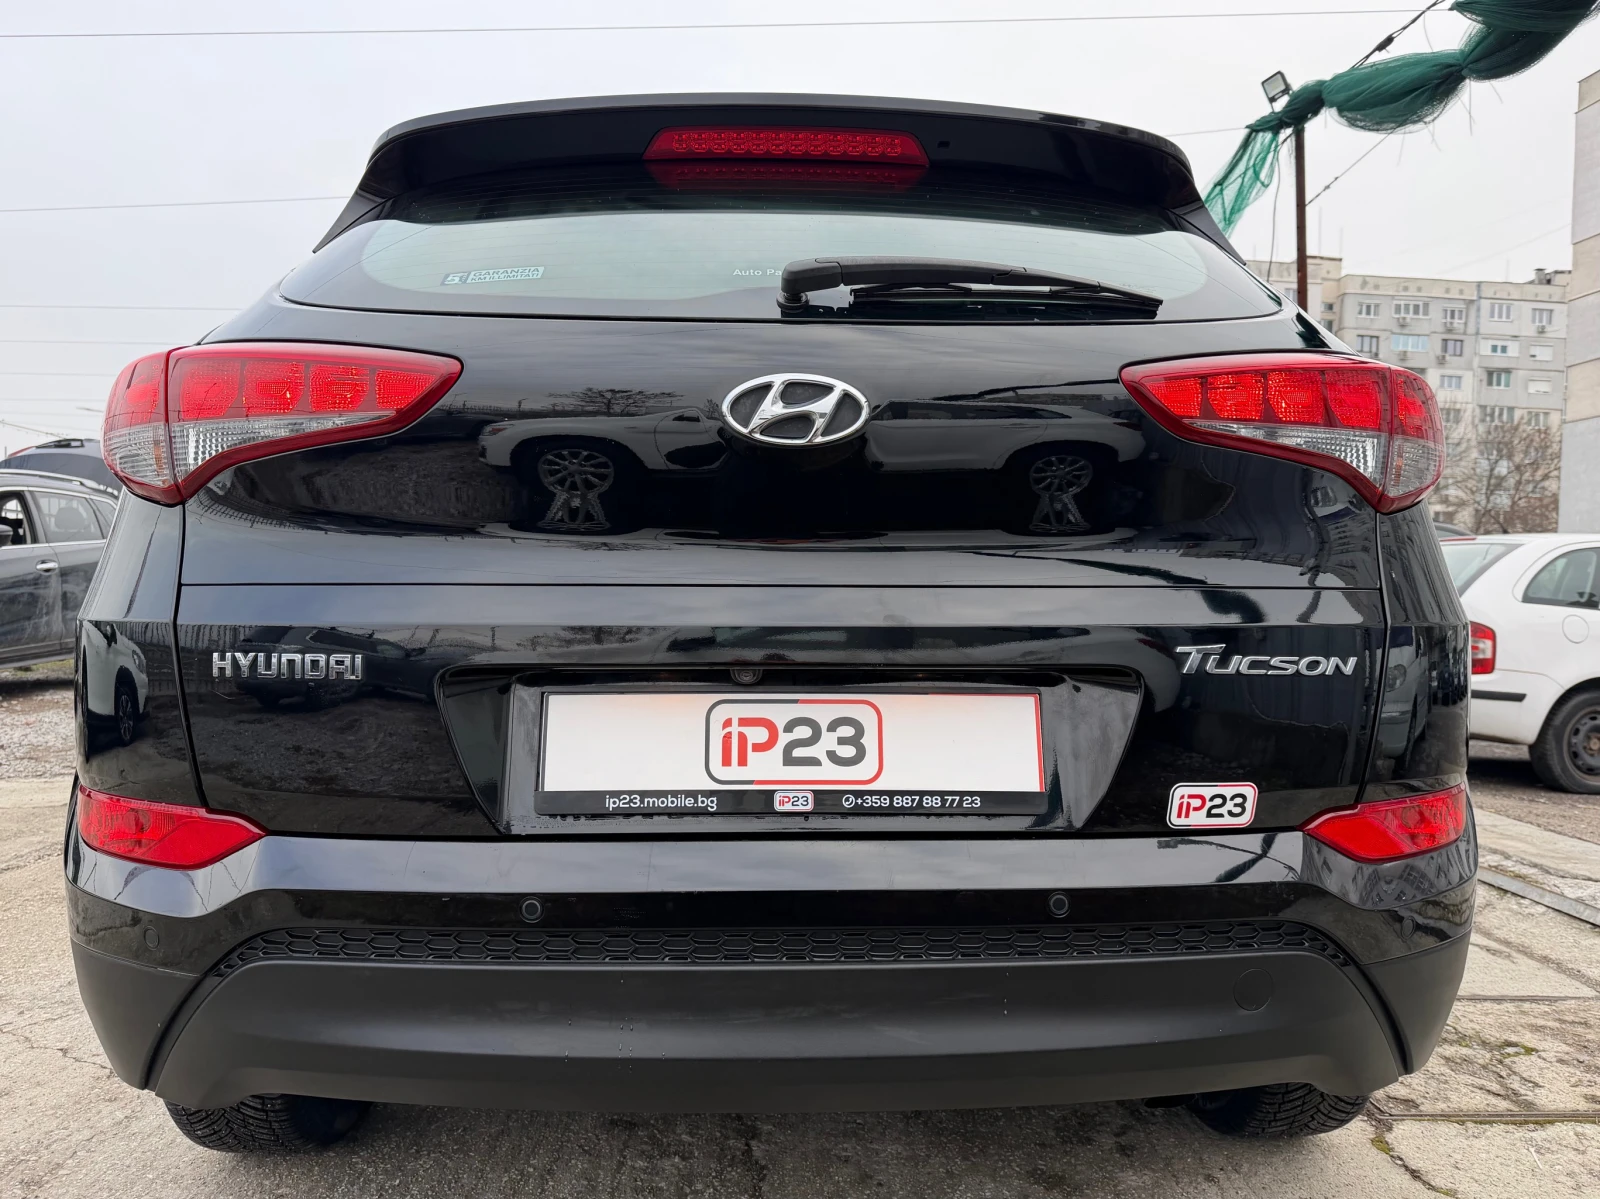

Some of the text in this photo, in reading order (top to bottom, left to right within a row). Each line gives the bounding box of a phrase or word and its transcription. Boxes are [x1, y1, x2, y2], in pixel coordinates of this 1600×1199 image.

[473, 268, 540, 277] GARANZIA
[212, 652, 362, 679] HYUNDAI
[605, 794, 718, 812] ip23.mobile.bg
[855, 796, 981, 808] +359 887 88 77 23
